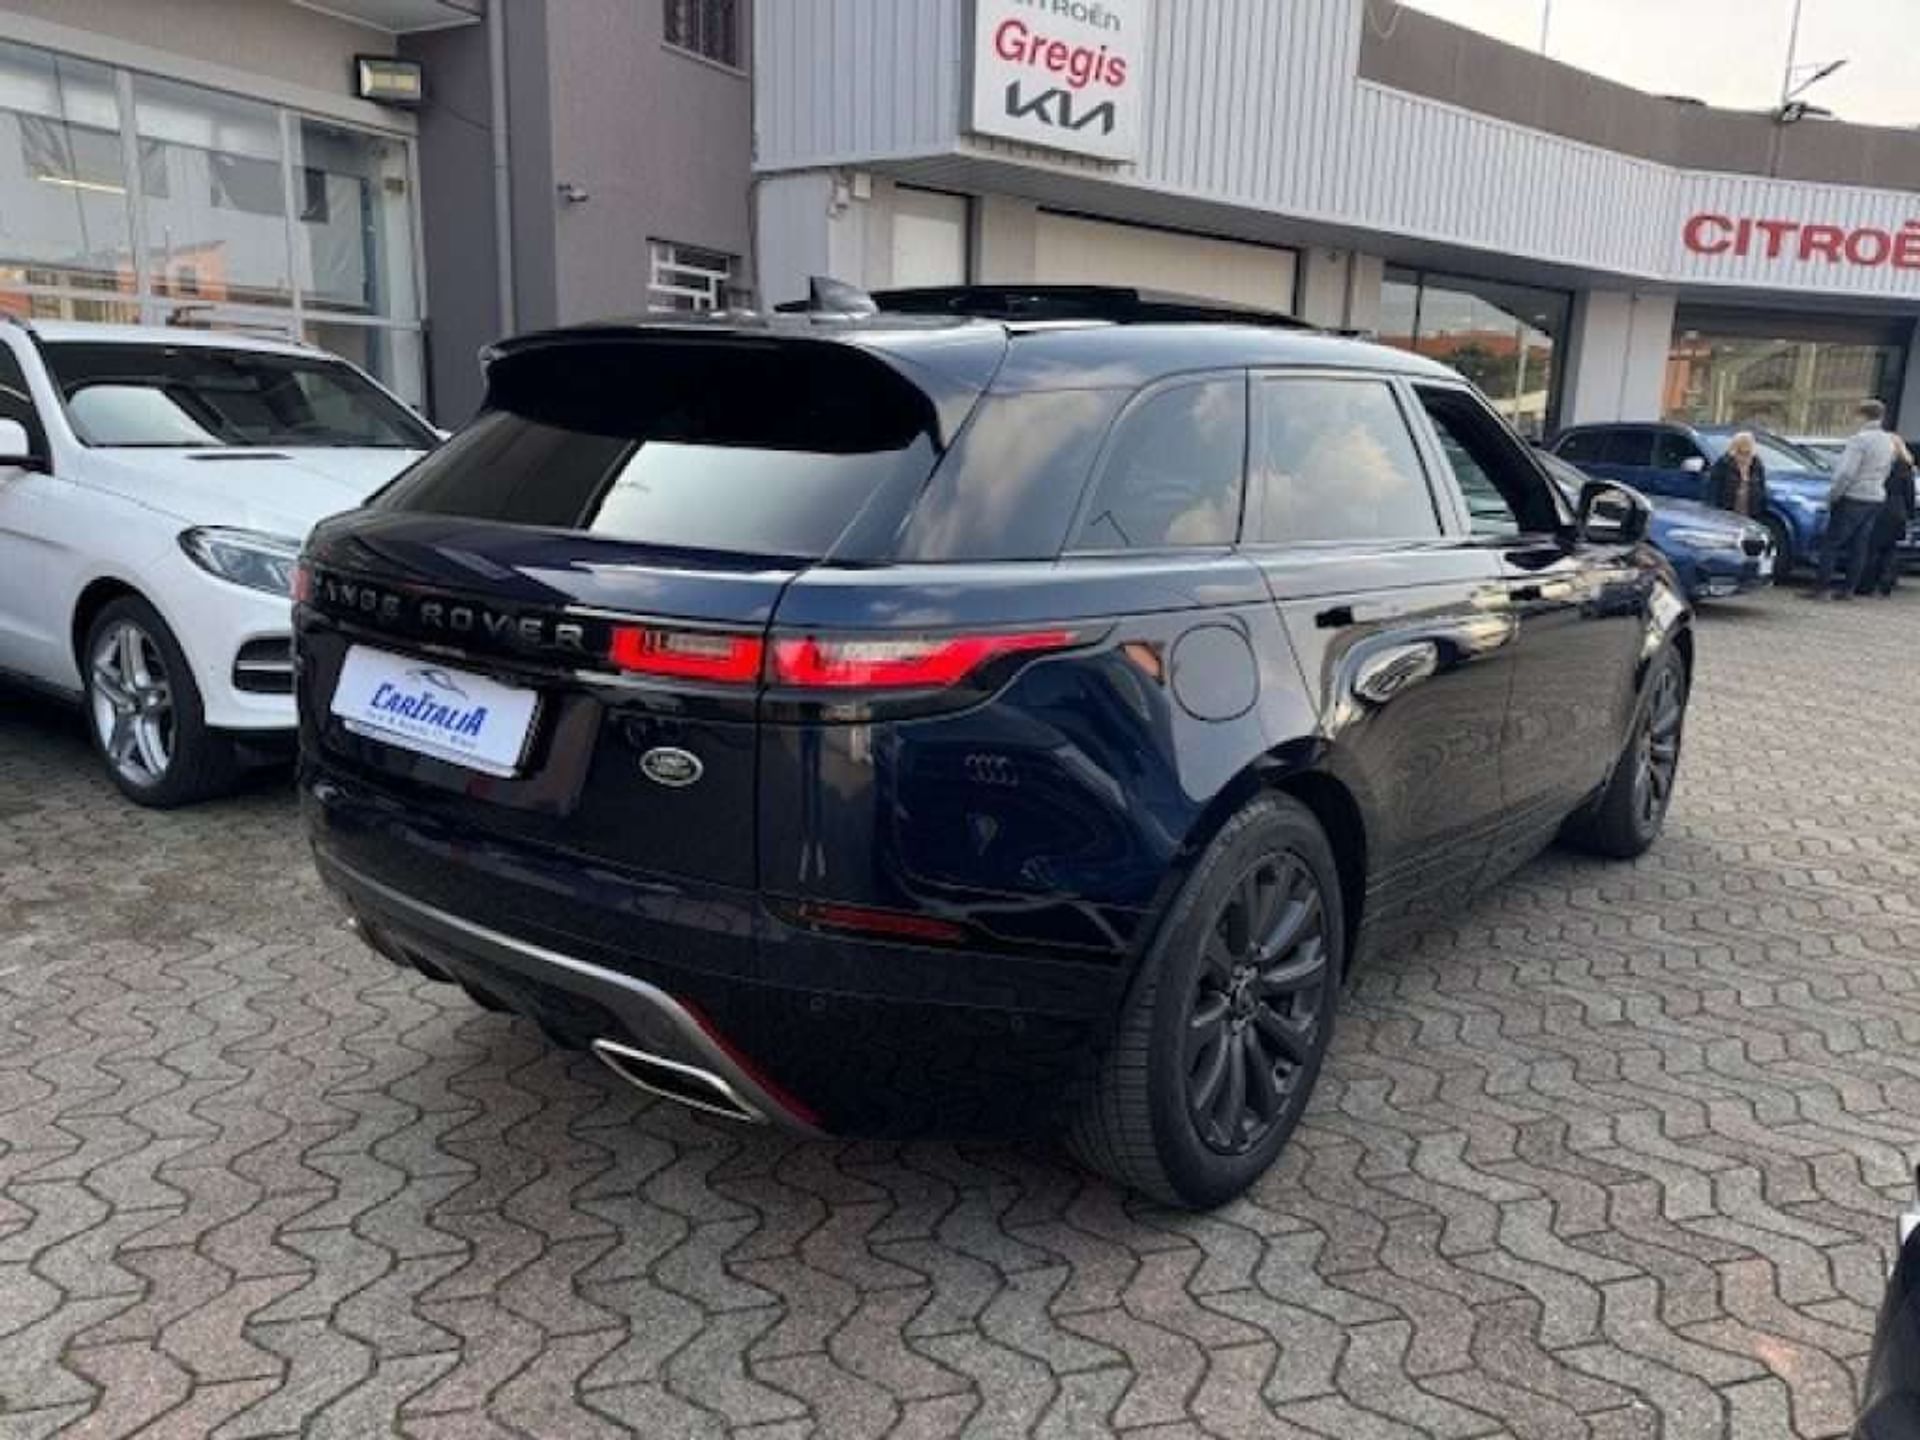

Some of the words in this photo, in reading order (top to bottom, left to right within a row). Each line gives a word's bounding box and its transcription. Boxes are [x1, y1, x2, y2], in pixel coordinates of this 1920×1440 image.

[995, 19, 1127, 88] Gregis
[315, 571, 401, 617] ANGE
[420, 600, 585, 652] ROVER
